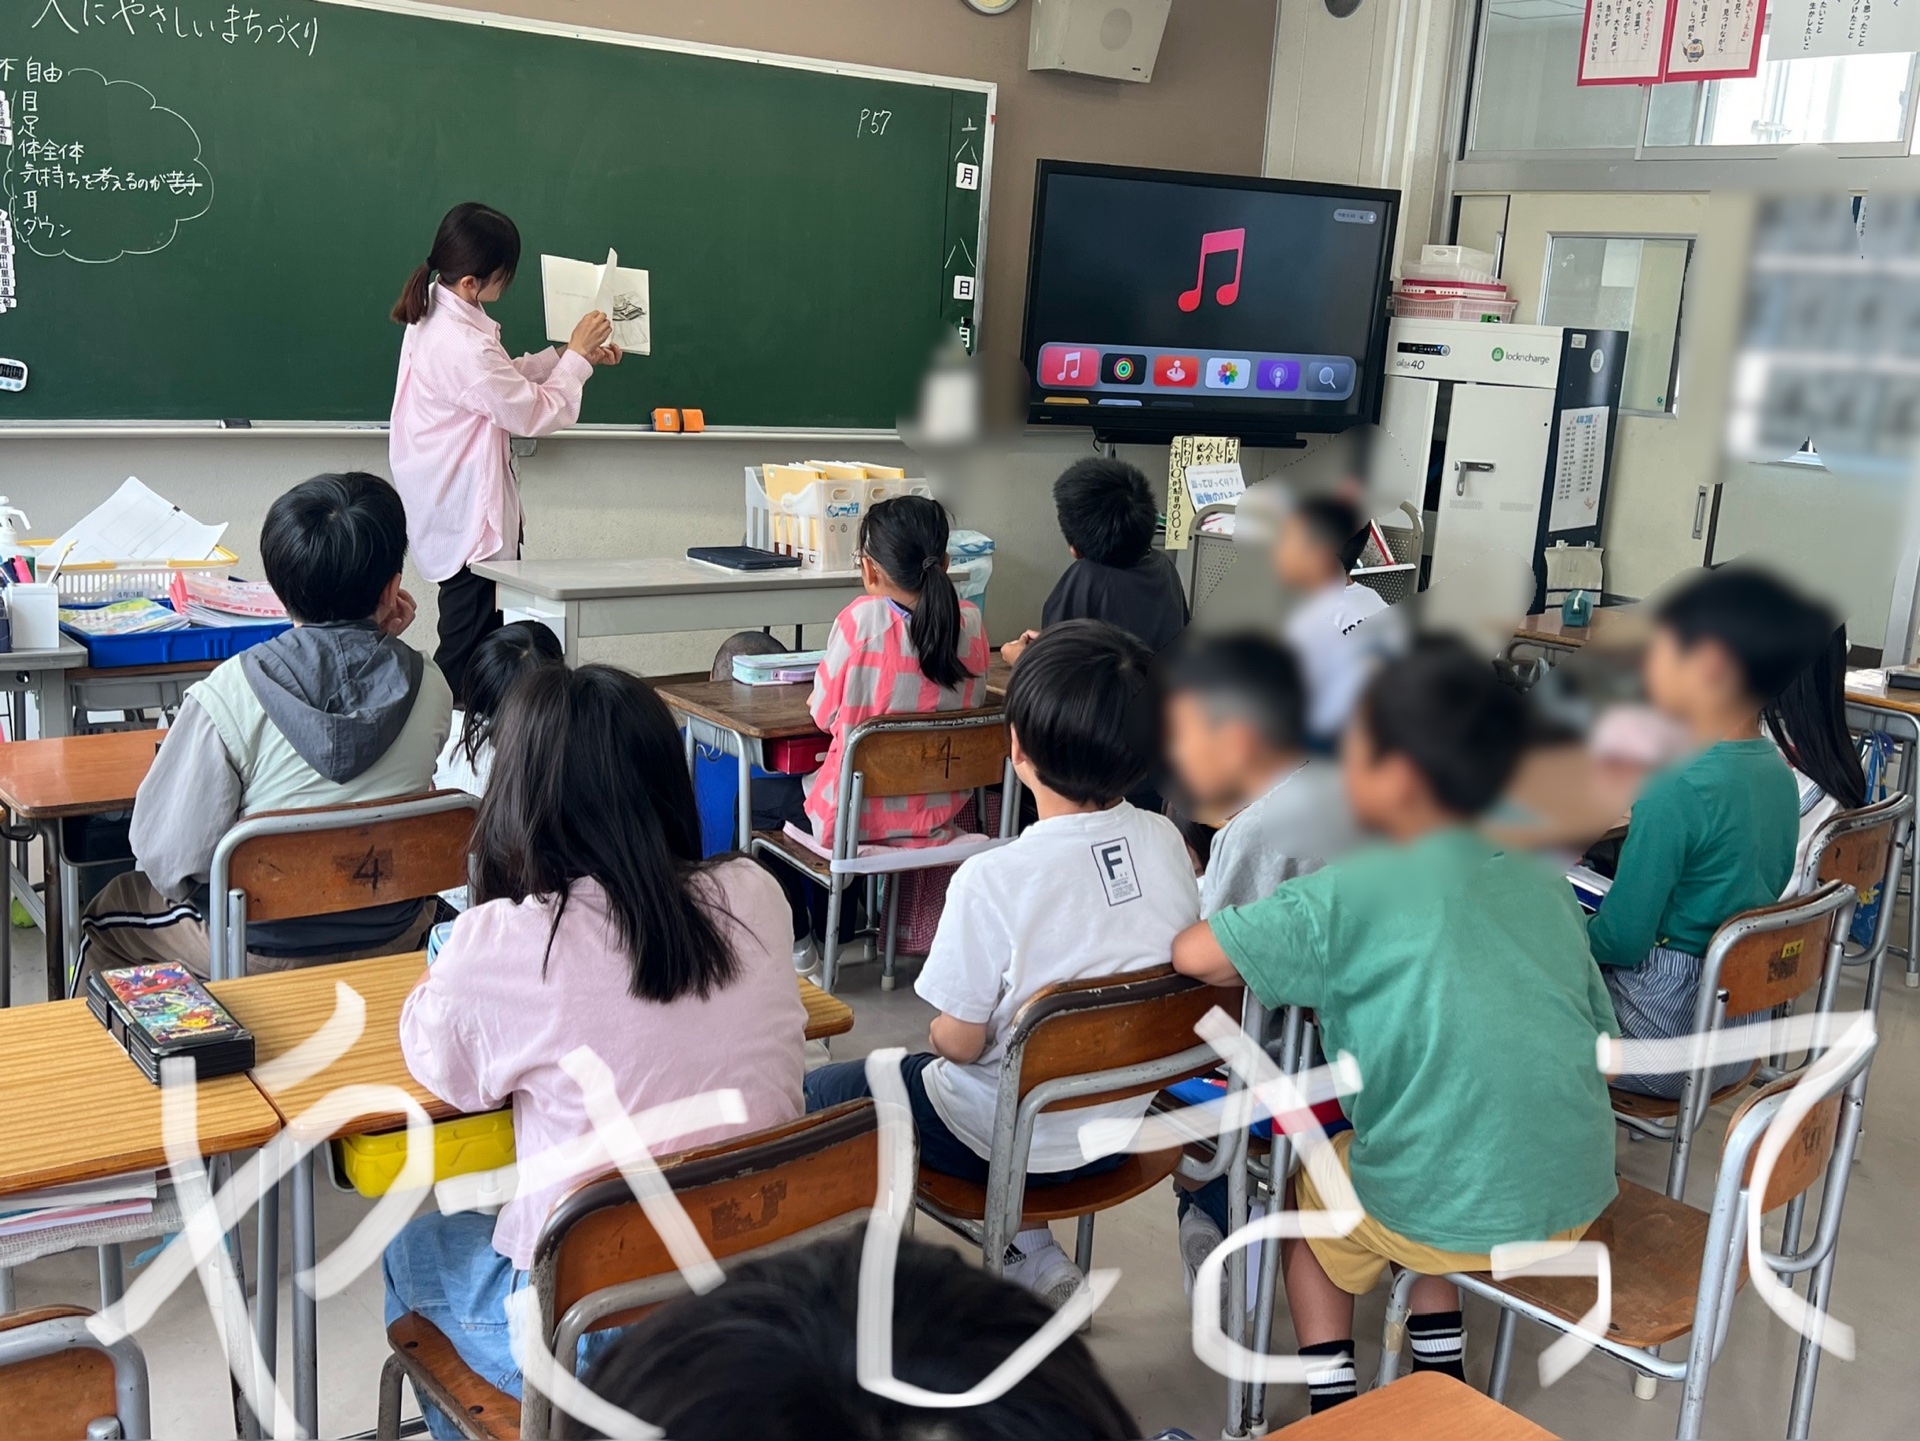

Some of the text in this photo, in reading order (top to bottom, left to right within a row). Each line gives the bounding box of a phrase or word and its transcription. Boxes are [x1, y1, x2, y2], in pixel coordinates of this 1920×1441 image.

[22, 90, 38, 111] 目
[17, 115, 39, 138] 足
[17, 138, 85, 164] 体全体
[23, 191, 38, 213] 耳
[22, 214, 72, 238] ダウン
[352, 844, 384, 894] 4
